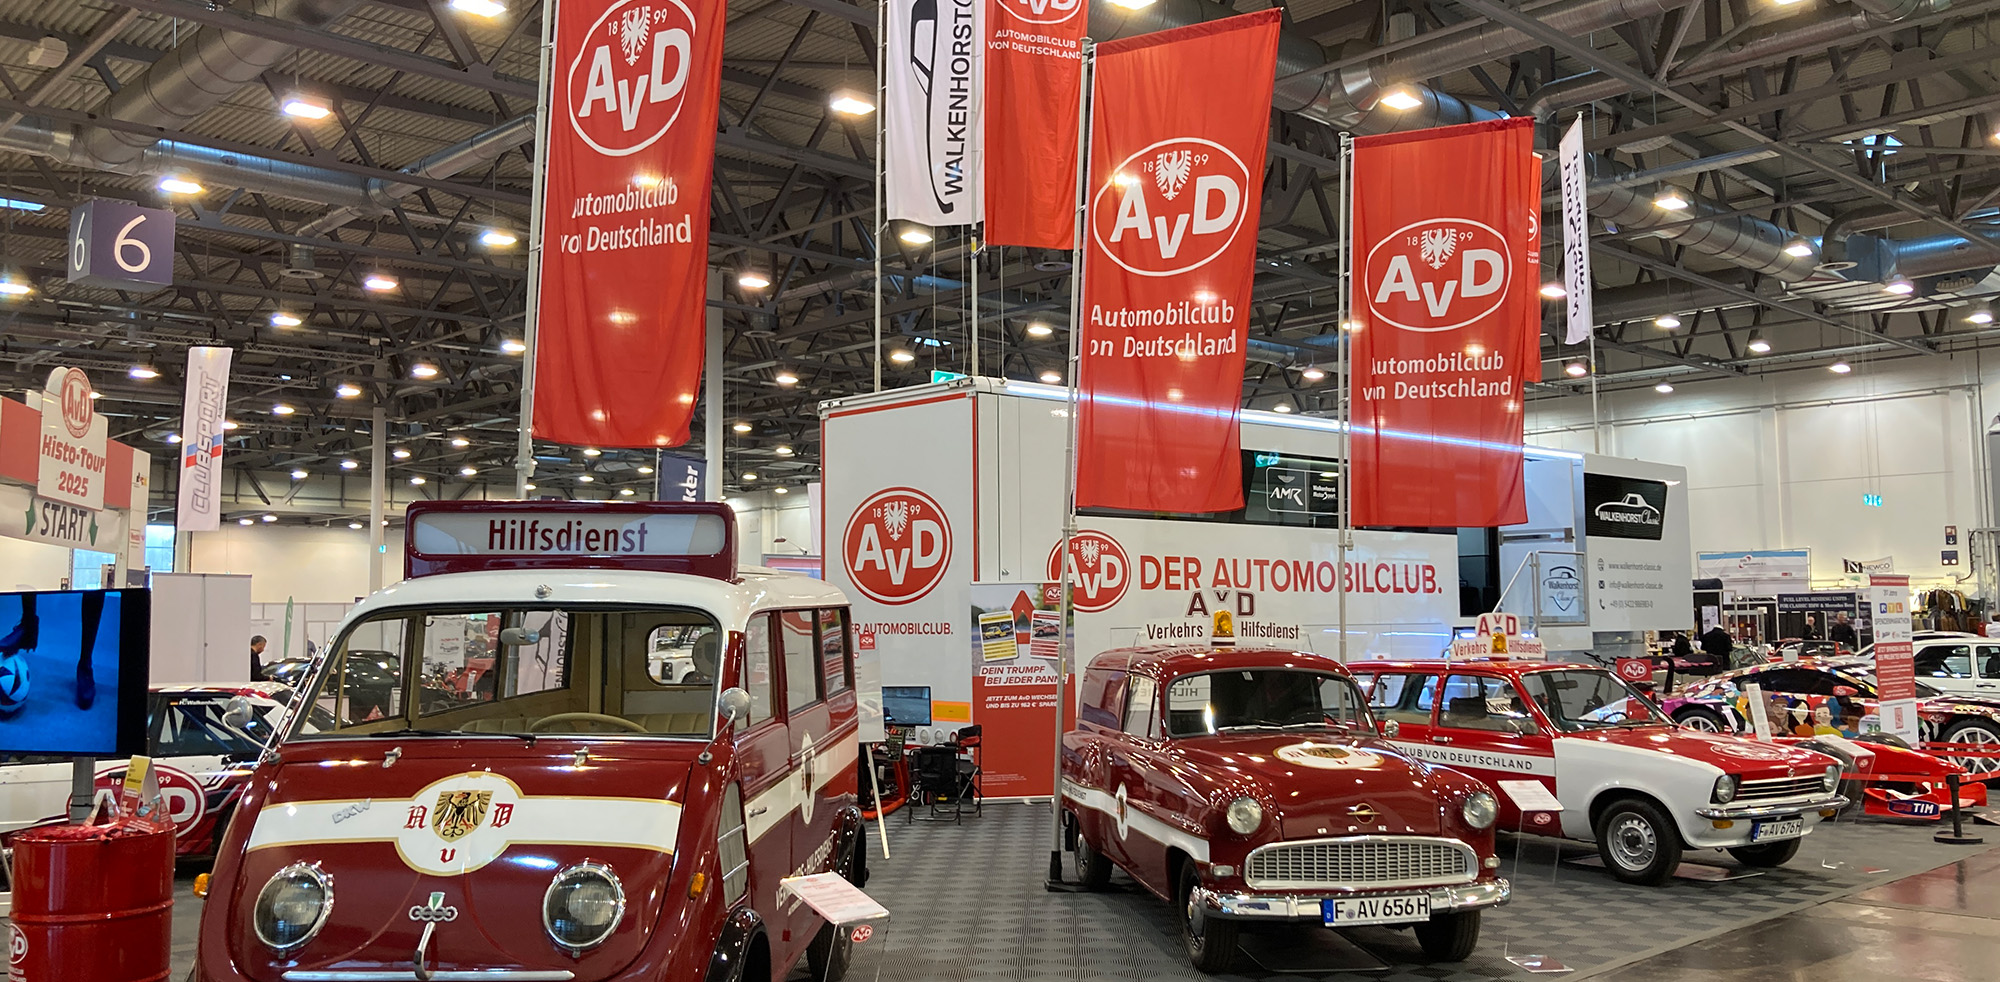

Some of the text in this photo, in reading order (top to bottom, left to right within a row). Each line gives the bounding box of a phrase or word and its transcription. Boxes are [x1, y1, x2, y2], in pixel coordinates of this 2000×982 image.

[607, 9, 668, 36] 18 99
[988, 41, 1082, 60] VON DEUTSCHLAND
[995, 30, 1077, 49] AUTOMOBILCLUB
[578, 28, 691, 131] AvD
[945, 8, 972, 196] WALKENHORST
[1143, 154, 1209, 173] 18 99
[1109, 174, 1240, 259] AvD
[74, 212, 85, 272] 6
[114, 214, 151, 273] 6
[586, 214, 692, 252] Deutschland
[1406, 231, 1474, 247] 18 99
[1375, 248, 1505, 318] AvD
[1091, 299, 1235, 328] Automobilclub
[1091, 329, 1237, 358] on Deutschland
[1363, 375, 1513, 401] vn Deutschland
[42, 434, 106, 473] Histo-Tour
[191, 371, 220, 515] CLUBSPORT
[58, 471, 89, 498] 2025
[682, 465, 699, 502] ker
[1270, 487, 1303, 506] AMR
[41, 501, 87, 542] START
[872, 505, 921, 519] 18 99
[488, 519, 648, 553] Hilfsdienst
[854, 519, 944, 586] AvD
[1140, 555, 1442, 594] DER AUTOMOBILCLUB.
[1879, 602, 1903, 614] RTL
[863, 622, 953, 635] AUTOMOBILCLUB.
[1147, 621, 1300, 640] Verkehrs Hilfsdienst
[1454, 640, 1542, 657] Verkehrs Hilfsdienst
[981, 666, 1046, 675] DEIN TRUMPF
[986, 676, 1002, 685] BEI
[1003, 676, 1033, 685] JEDER
[1625, 665, 1646, 676] AvD
[1426, 750, 1447, 760] VON
[1450, 752, 1533, 770] DEUTSCHLAND
[158, 776, 171, 784] 99
[332, 798, 371, 824] DKW
[1913, 803, 1934, 815] TIM
[1335, 901, 1346, 919] F
[1357, 900, 1379, 918] AV
[1383, 898, 1414, 917] 656
